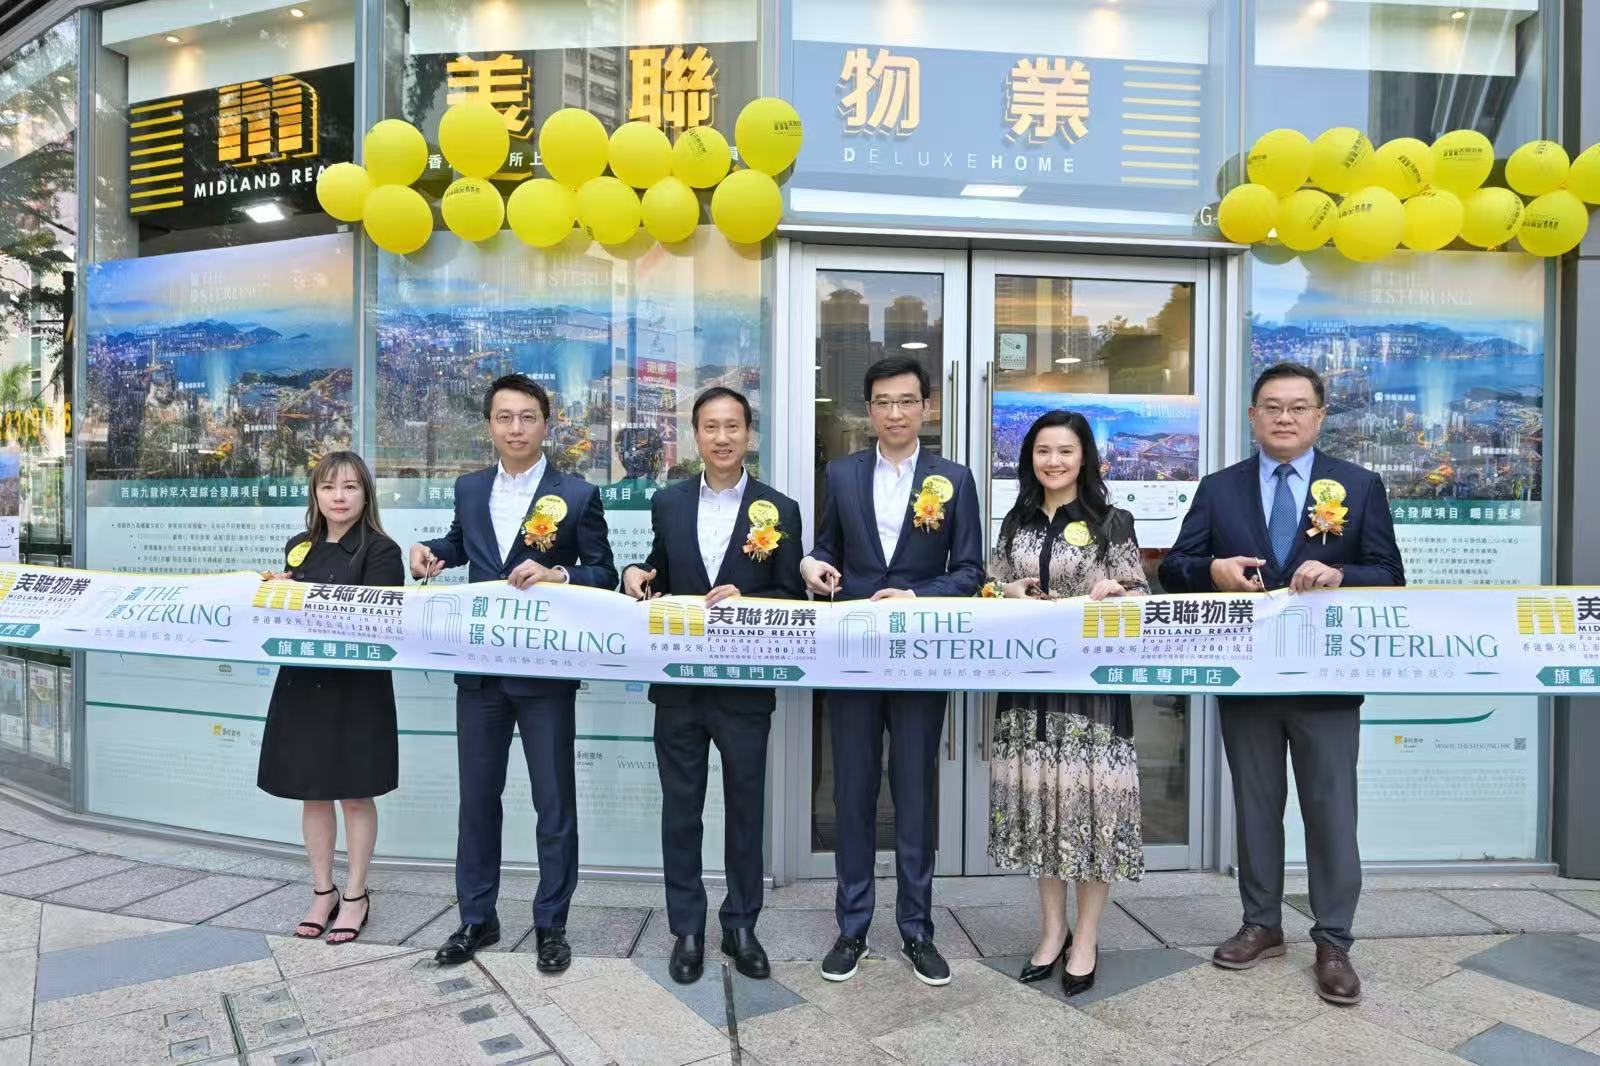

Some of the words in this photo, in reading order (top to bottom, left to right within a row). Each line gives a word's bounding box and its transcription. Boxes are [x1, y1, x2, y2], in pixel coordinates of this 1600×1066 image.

[194, 172, 280, 199] MIDLAND
[1390, 507, 1458, 519] 合發展項目
[13, 573, 92, 595] 美聯物業
[143, 586, 189, 601] THE
[122, 604, 232, 627] STERLING
[304, 603, 356, 613] MIDLAND
[362, 607, 402, 616] REALTY
[496, 597, 550, 622] THE
[707, 606, 817, 627] 美聯物業
[1144, 600, 1254, 625] 美聯物業
[1350, 606, 1410, 628] THE
[0, 624, 32, 636] 門店
[913, 611, 974, 633] THE
[278, 640, 381, 659] 旗艦專門店
[490, 625, 627, 655] STERLING
[912, 638, 1057, 660] STERLING
[1350, 634, 1500, 658] STERLING
[680, 665, 788, 679] 旗艦專門店
[1108, 668, 1222, 683] 旗艦專門店
[1555, 668, 1595, 684] 旗艦
